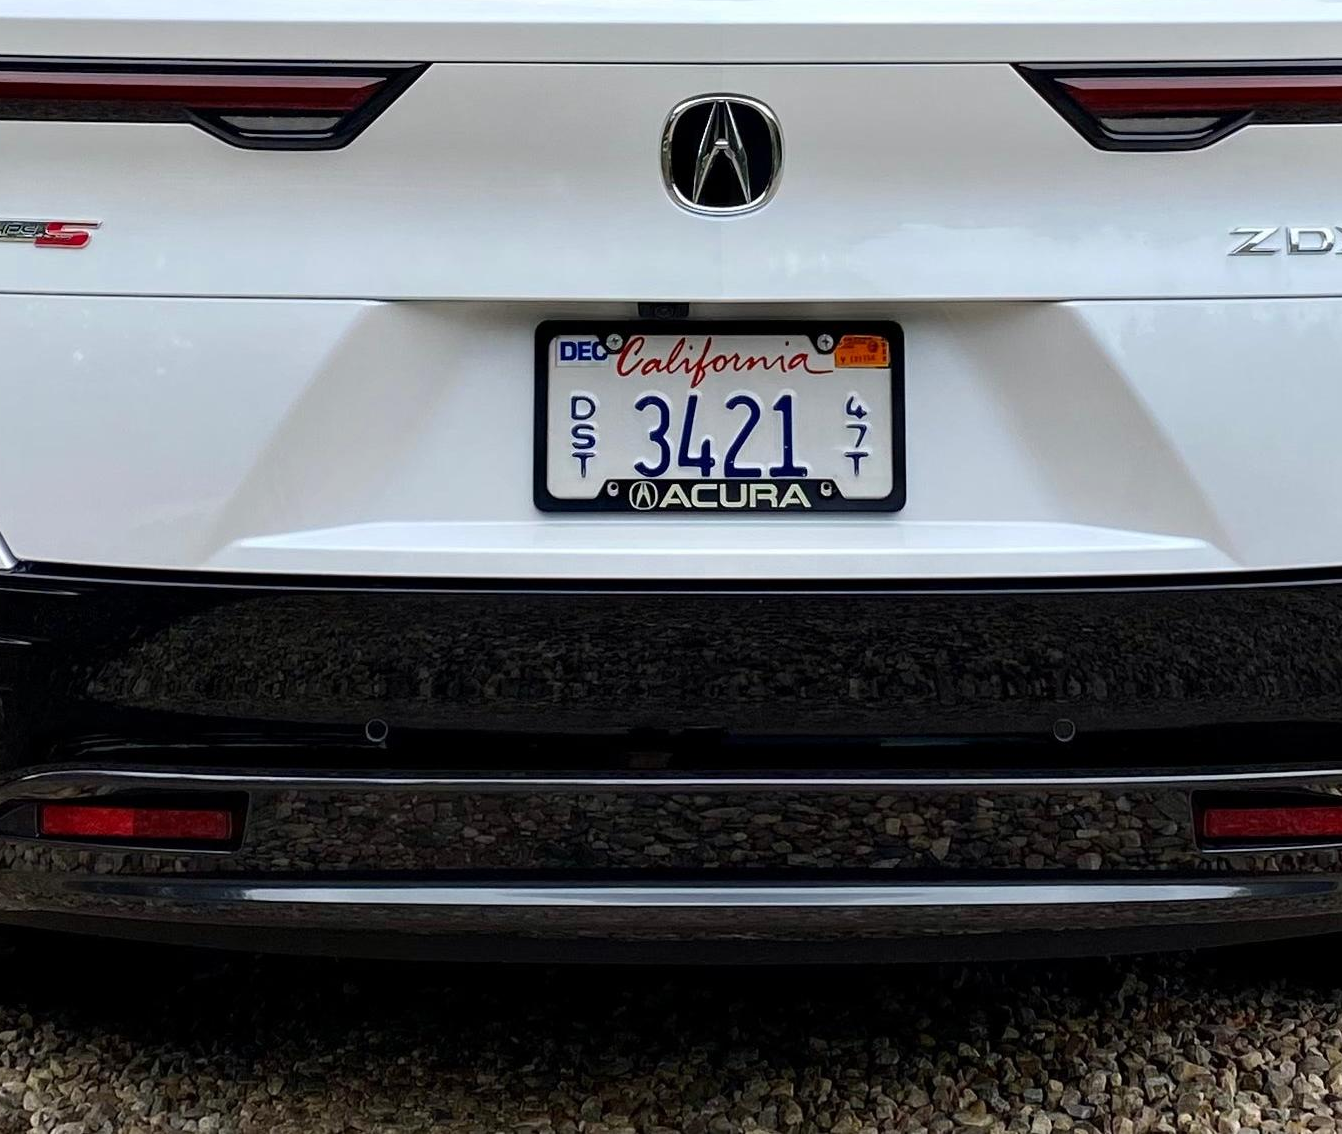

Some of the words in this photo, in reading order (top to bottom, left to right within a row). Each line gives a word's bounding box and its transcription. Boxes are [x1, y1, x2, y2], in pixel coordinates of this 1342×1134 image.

[34, 219, 103, 249] S
[560, 341, 608, 361] DEC
[616, 336, 834, 388] California
[634, 395, 808, 478] 3421
[659, 483, 811, 509] ACURA
